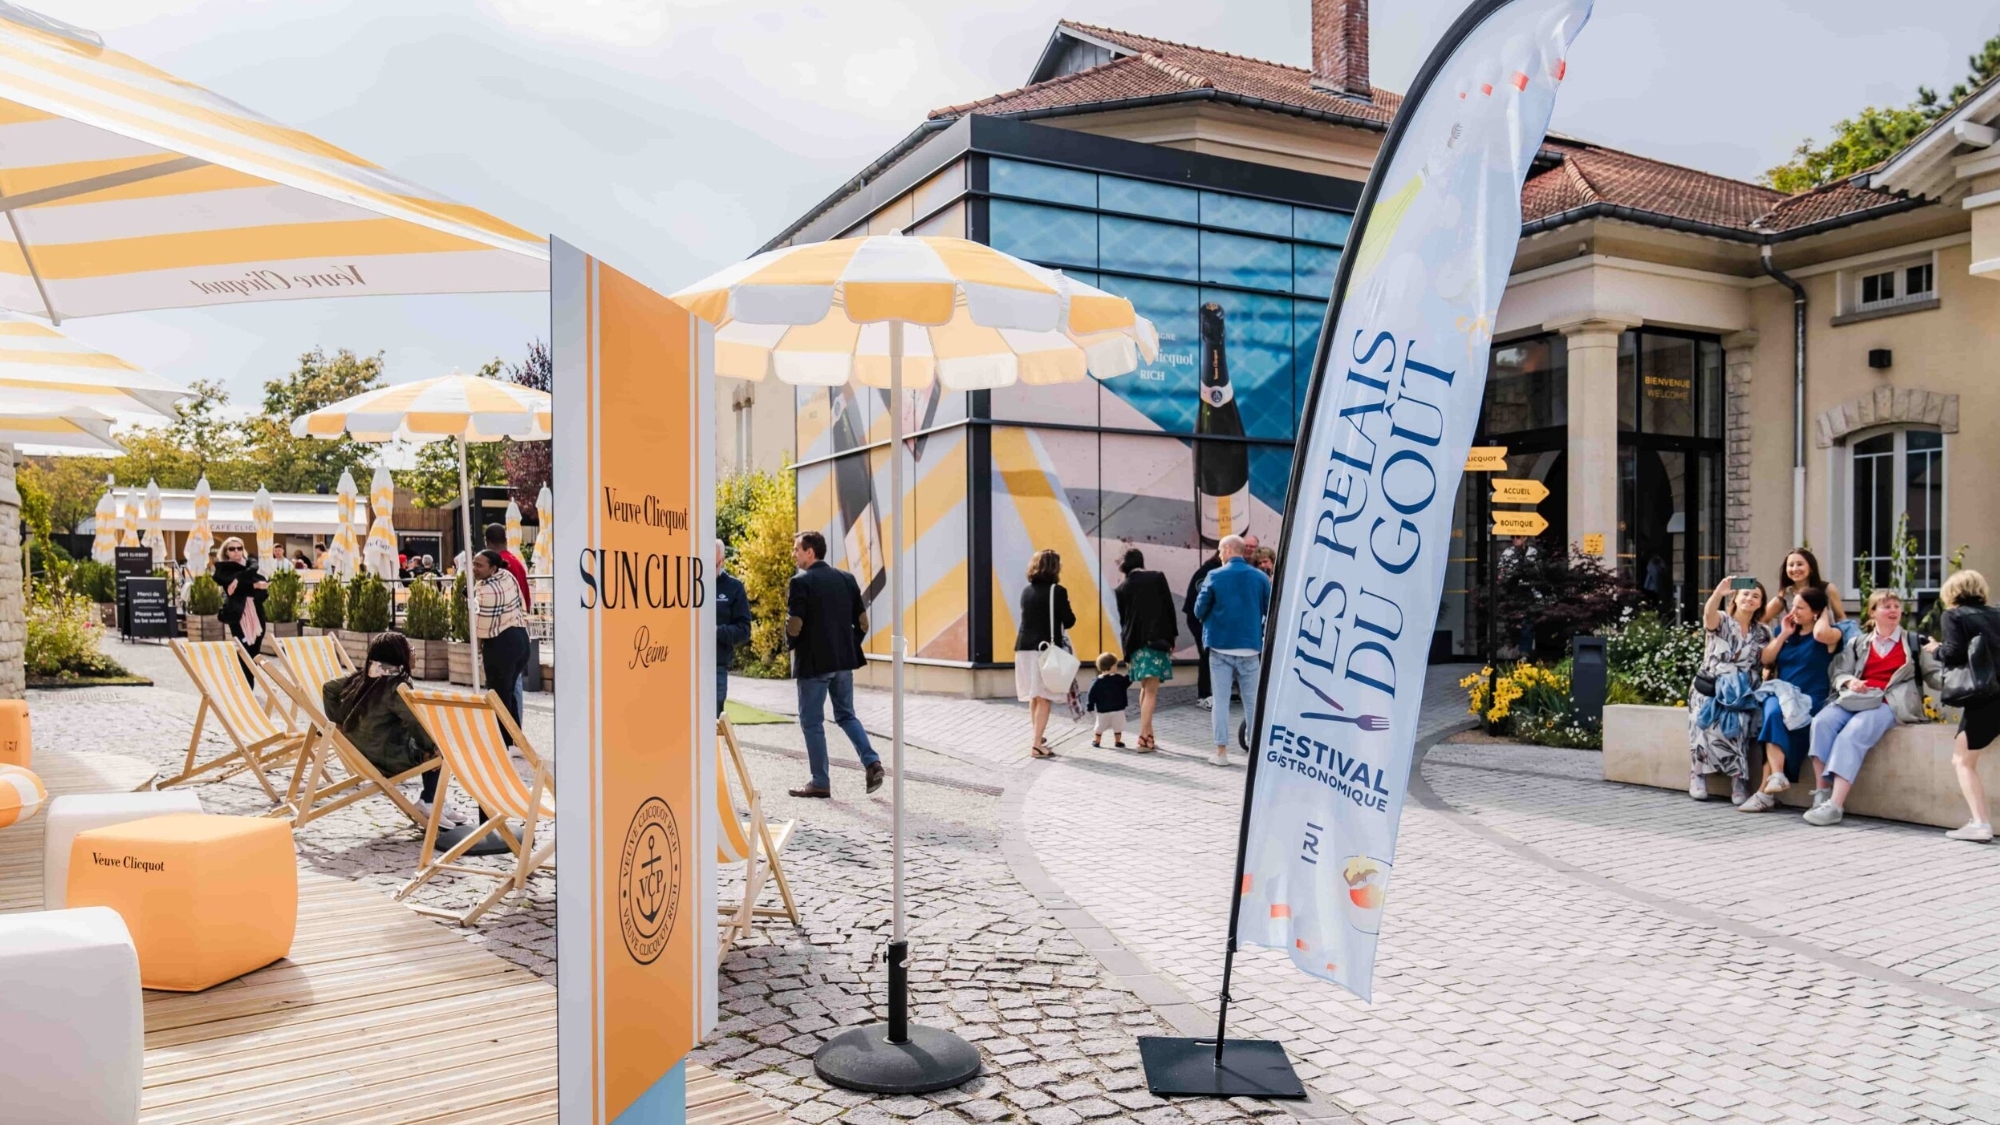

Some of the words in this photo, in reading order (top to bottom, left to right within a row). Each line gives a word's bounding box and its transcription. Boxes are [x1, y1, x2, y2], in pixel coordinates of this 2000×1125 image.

[1140, 369, 1165, 381] RICH
[1155, 349, 1194, 367] licquot
[1644, 375, 1691, 389] BIENVENUE
[1646, 389, 1689, 400] WELCOME
[1313, 329, 1397, 561] RELAIS
[1369, 340, 1456, 575] GOÛT
[604, 486, 641, 525] Veuve
[644, 494, 689, 536] Clicquot
[1503, 487, 1531, 495] ACCUEIL
[210, 523, 230, 531] CAFÉ
[1500, 520, 1534, 528] BOUTIQUE
[579, 547, 640, 610] SUN
[644, 553, 705, 610] CLUB
[628, 625, 670, 670] Reims
[1294, 576, 1347, 675] LES
[1344, 585, 1404, 700] DU
[1268, 724, 1389, 796] FESTIVAL
[92, 851, 121, 867] Veuve
[123, 855, 165, 873] Clicquot
[622, 826, 638, 878] VEUVE
[638, 805, 668, 828] CLICQUOT
[638, 869, 664, 899] VCP
[623, 907, 640, 951] VEUVE
[639, 920, 669, 956] CLICQUOT
